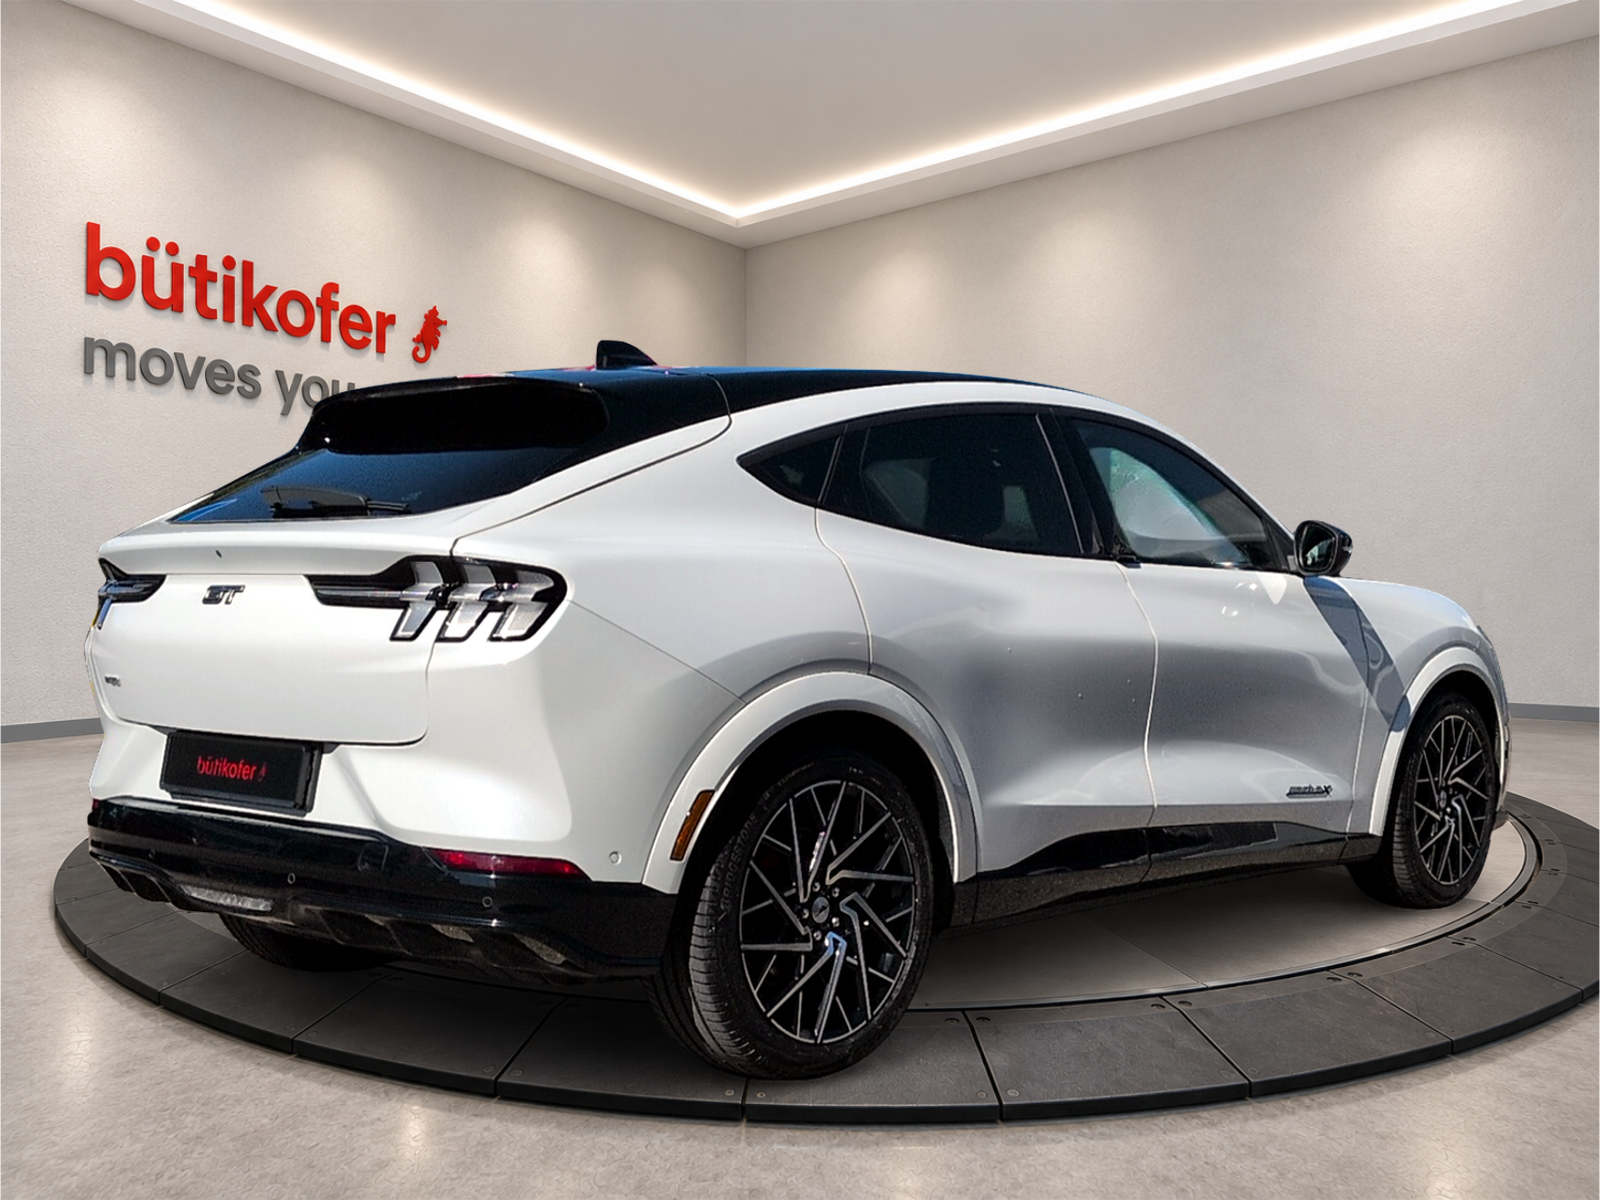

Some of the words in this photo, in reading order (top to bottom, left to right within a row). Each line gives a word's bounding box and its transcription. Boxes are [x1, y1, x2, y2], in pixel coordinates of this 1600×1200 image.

[86, 221, 396, 354] bütikofer
[84, 336, 262, 400] moves
[196, 755, 257, 782] bütikofer
